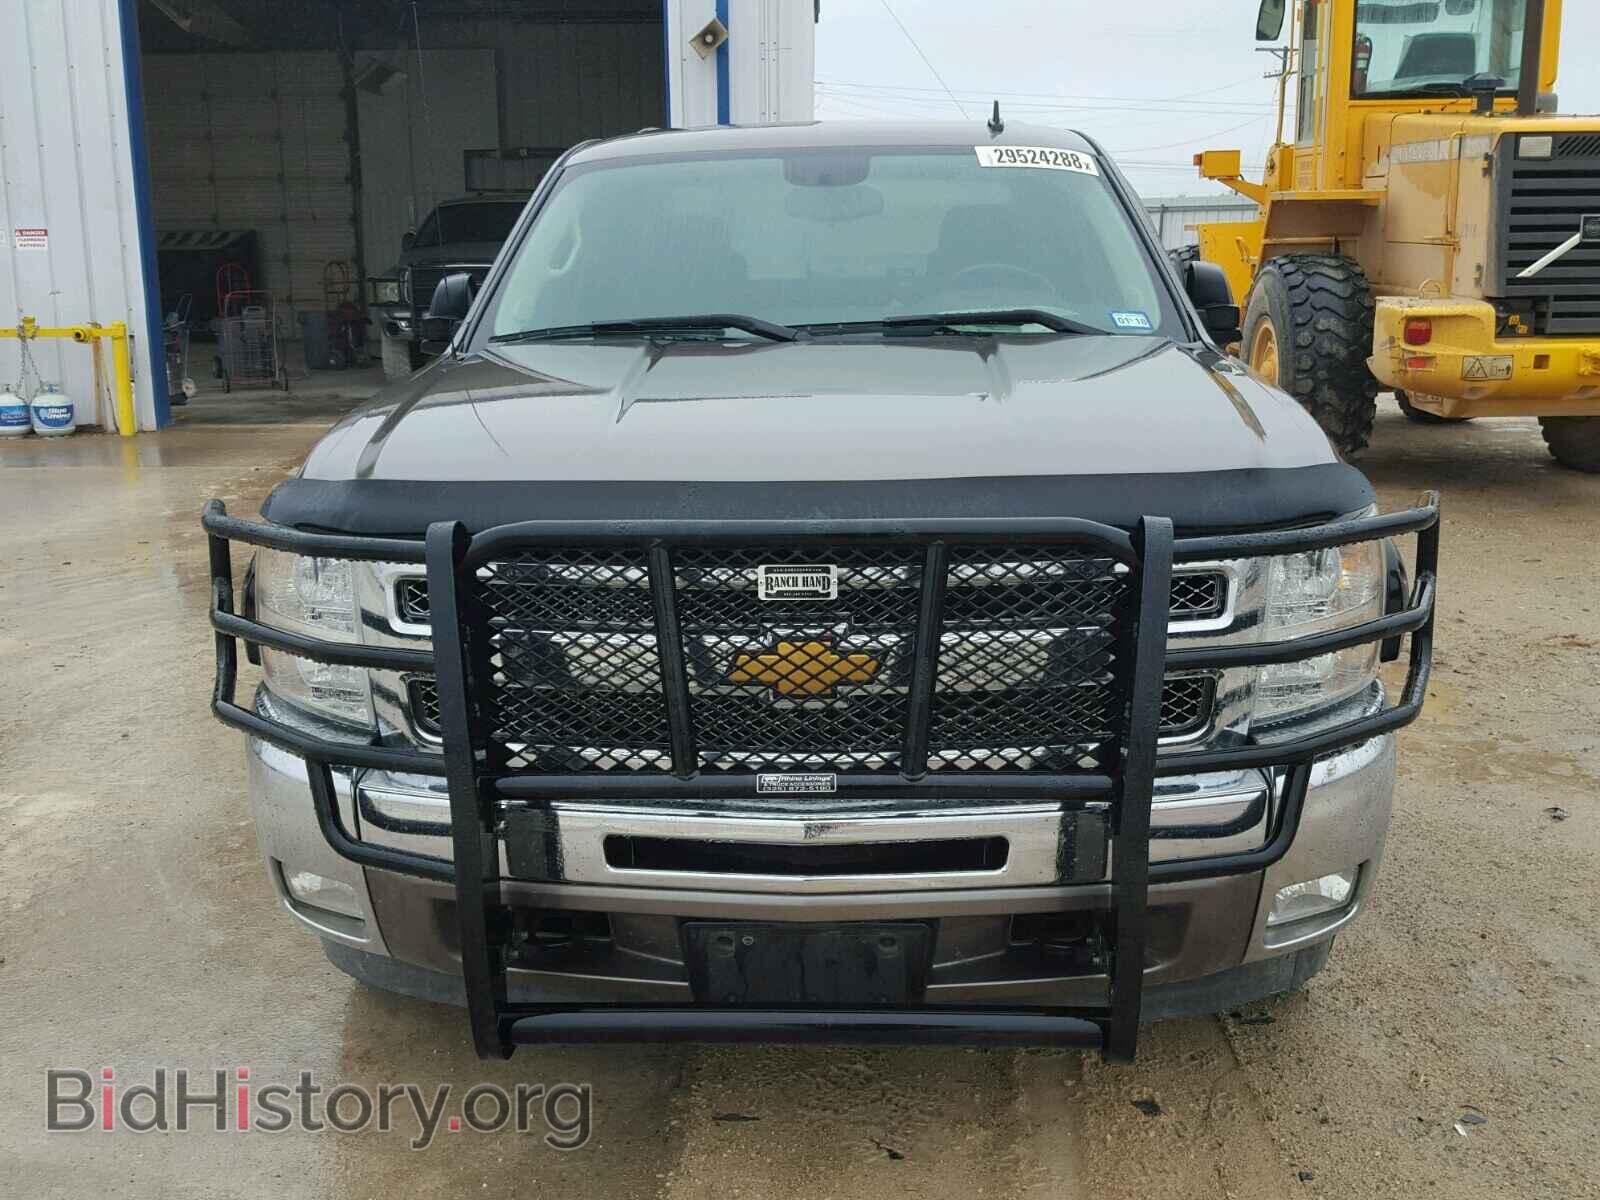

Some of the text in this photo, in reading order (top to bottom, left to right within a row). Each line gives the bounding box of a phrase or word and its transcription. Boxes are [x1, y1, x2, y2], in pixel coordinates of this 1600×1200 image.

[993, 148, 1082, 169] 29524288
[765, 576, 831, 591] RANCH HAND
